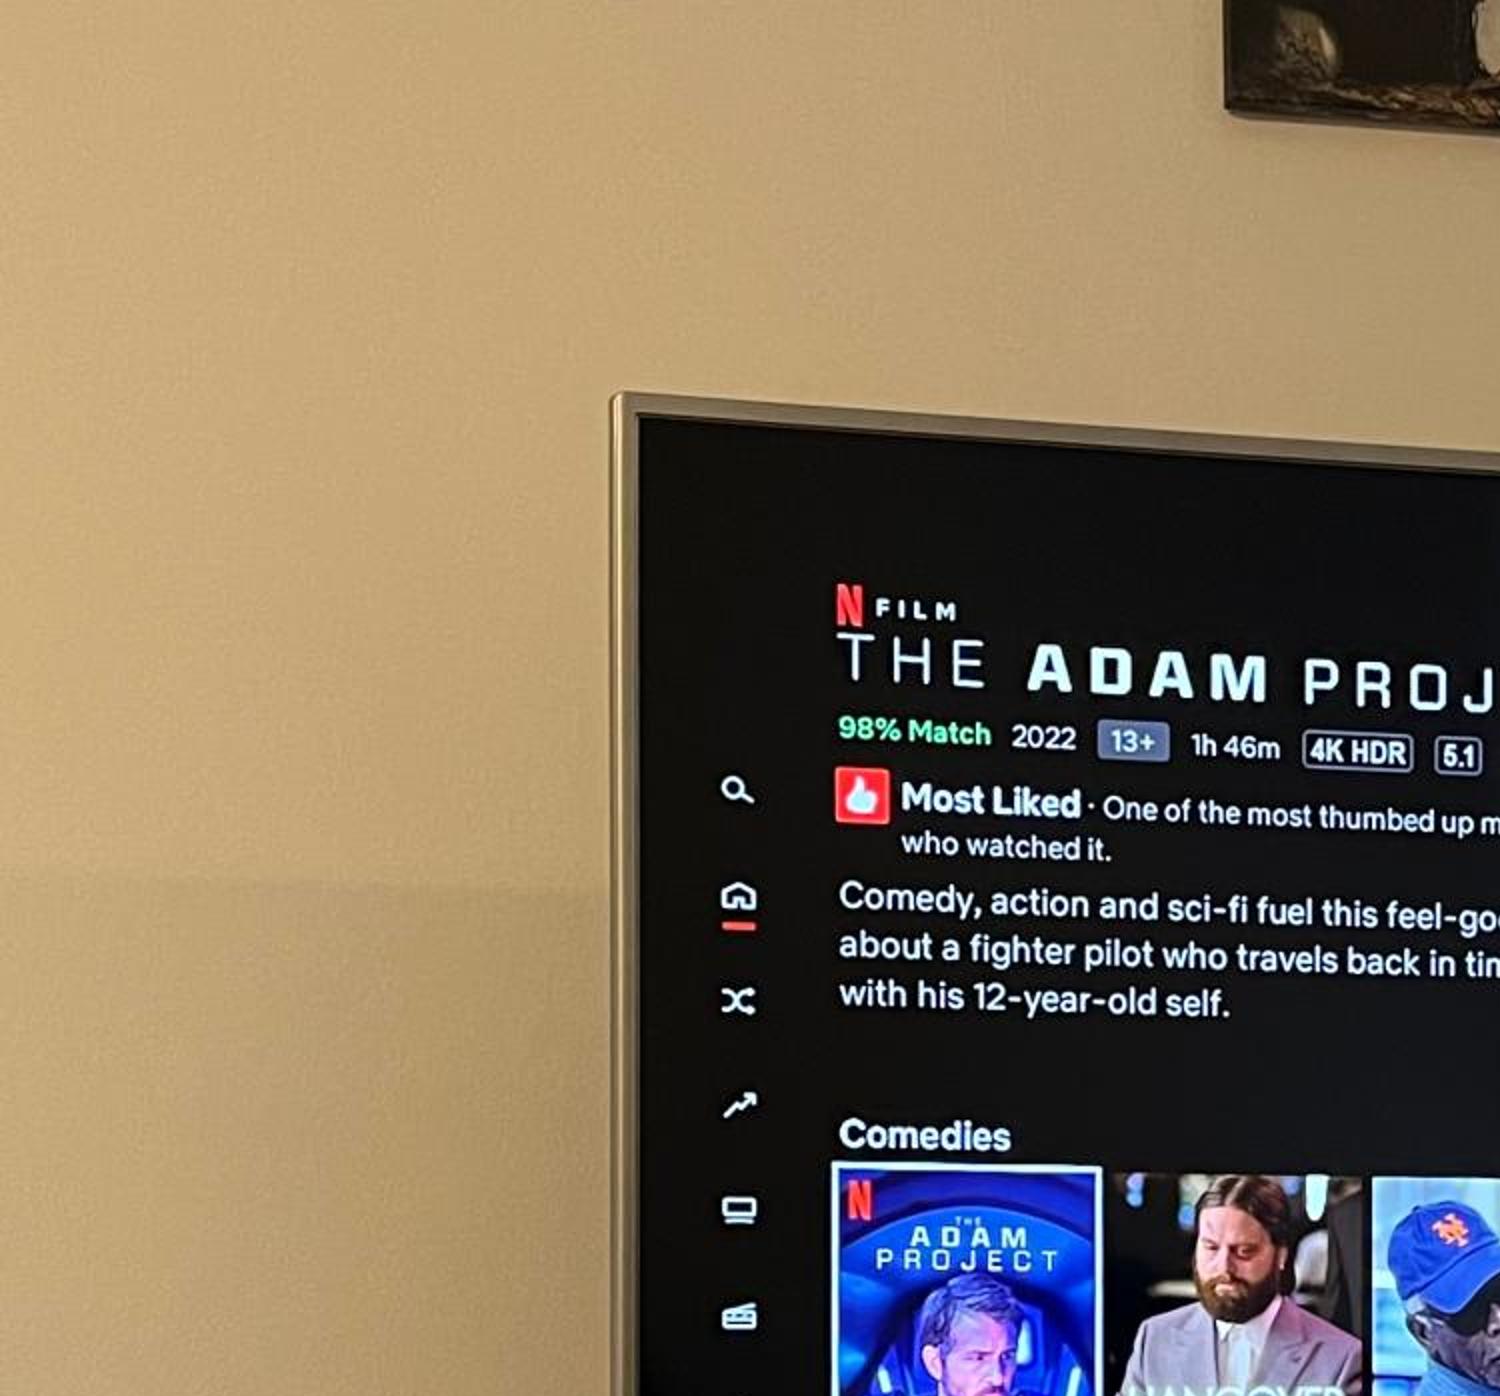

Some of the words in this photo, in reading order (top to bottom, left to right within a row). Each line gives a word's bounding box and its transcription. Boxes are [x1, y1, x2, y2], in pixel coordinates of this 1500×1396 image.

[875, 597, 957, 621] FILM
[836, 632, 985, 689] THE
[1027, 643, 1267, 702] ADAM
[838, 715, 901, 742] 98%
[908, 719, 993, 746] Match
[1011, 724, 1077, 751] 2022
[1111, 729, 1155, 753] 13+
[1191, 733, 1217, 757] 1h
[1223, 735, 1280, 760] 46m
[1309, 738, 1344, 763] 4K
[1351, 739, 1407, 765] HDR
[1443, 743, 1476, 769] 5.1
[901, 781, 985, 815] Most
[993, 786, 1082, 818] Liked
[1103, 795, 1158, 824] One
[1164, 796, 1191, 823] of
[1199, 801, 1240, 825] the
[1247, 803, 1312, 828] most
[1319, 804, 1435, 833] thumbed
[1441, 813, 1474, 839] up
[901, 831, 959, 856] who
[967, 834, 1081, 861] watched
[1087, 836, 1112, 862] it.
[839, 881, 982, 920] Comedy,
[990, 888, 1089, 918] action
[1100, 892, 1159, 921] and
[1168, 895, 1248, 924] sci-fi
[1257, 896, 1313, 926] fuel
[1322, 899, 1378, 928] this
[839, 930, 933, 960] about
[942, 939, 961, 961] a
[970, 934, 1077, 971] fighter
[1084, 938, 1155, 972] pilot
[1162, 942, 1227, 971] who
[1236, 945, 1338, 974] travels
[1347, 946, 1420, 977] back
[1429, 950, 1456, 977] in
[839, 979, 907, 1007] with
[918, 980, 965, 1010] his
[973, 982, 1157, 1018] 12-year-old
[1166, 989, 1230, 1018] self.
[839, 1117, 1011, 1152] Comedies
[910, 1225, 1027, 1249] ADAM
[955, 1216, 981, 1226] THE
[876, 1248, 1057, 1272] PROJECT
